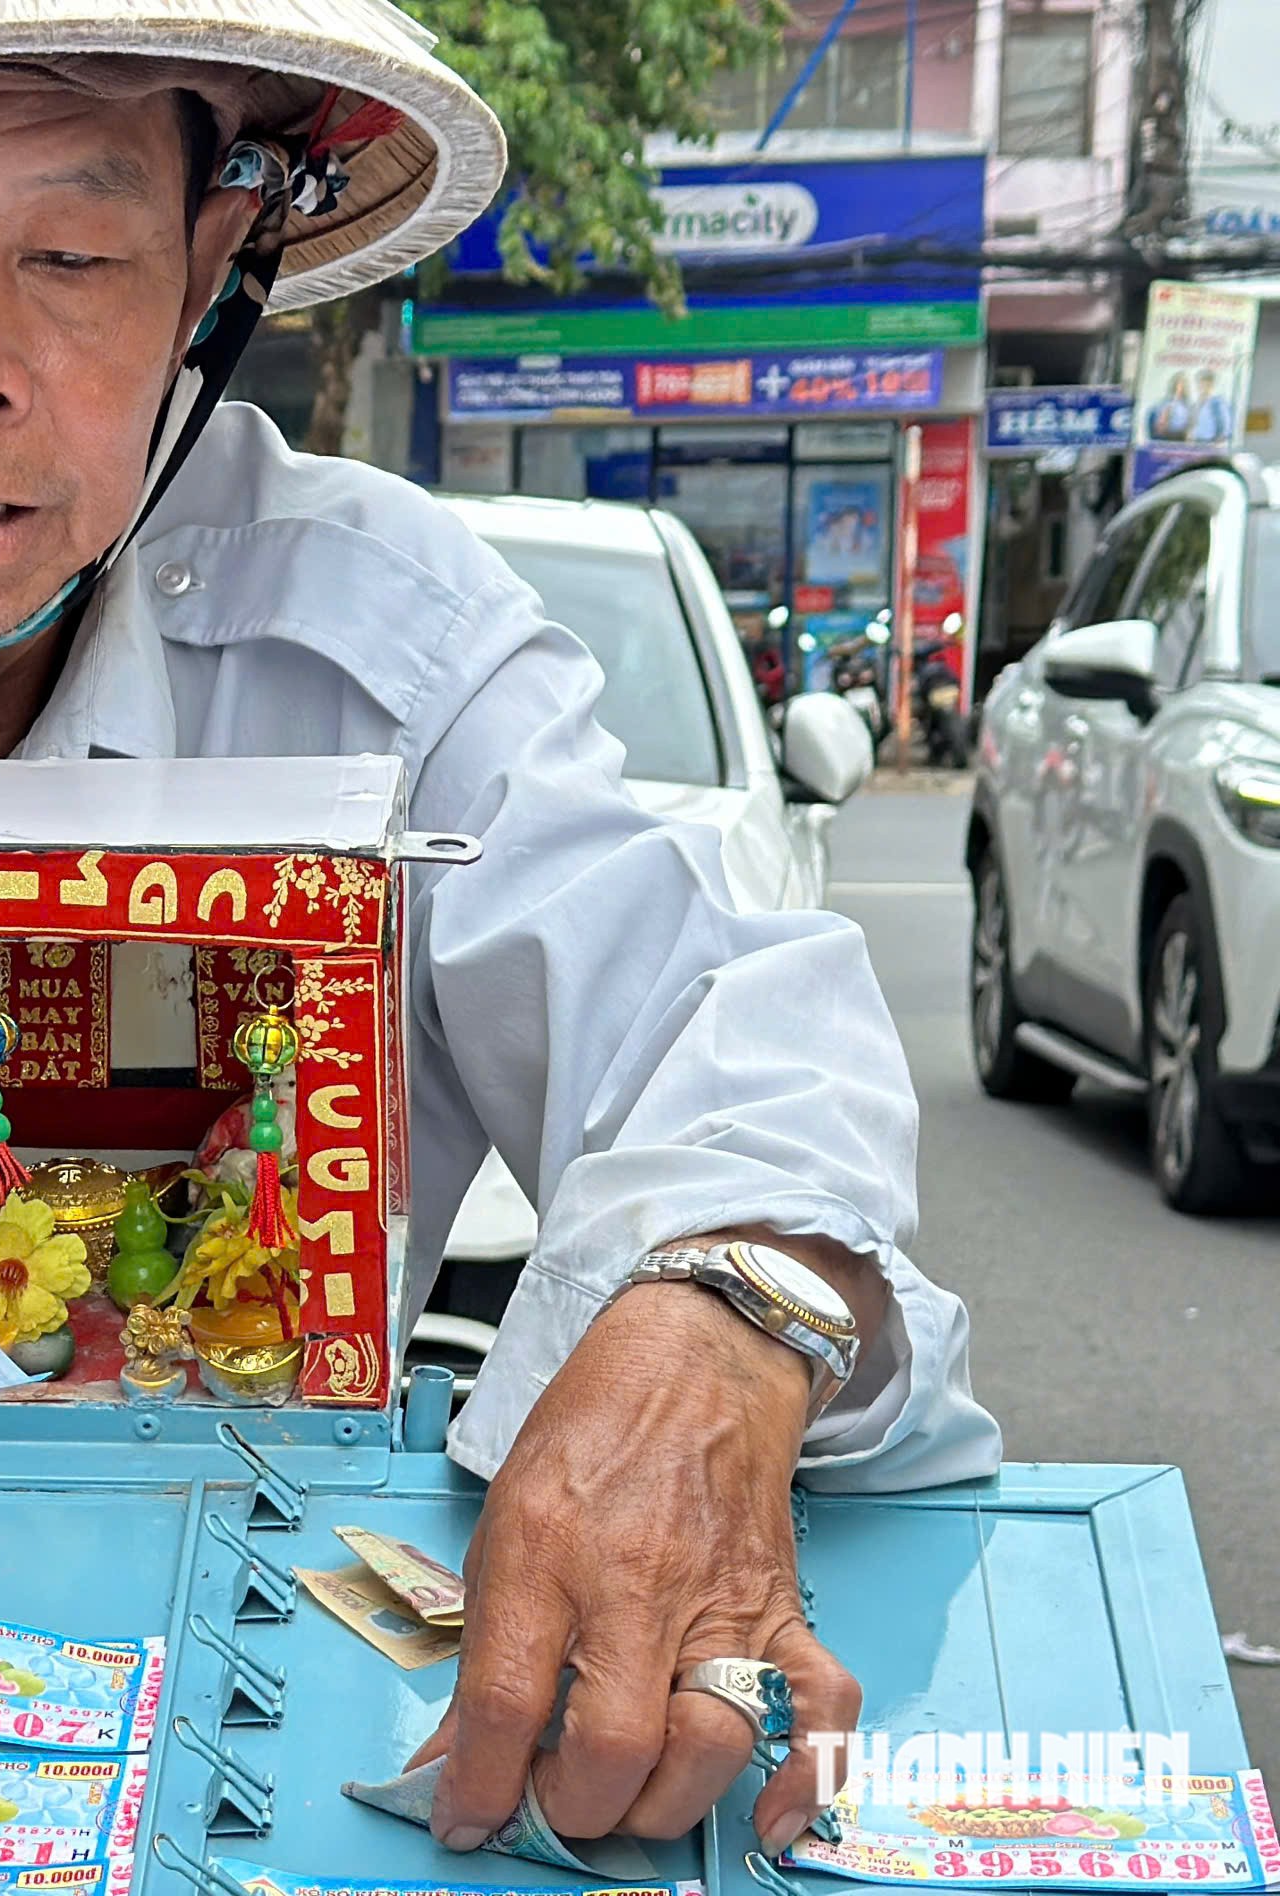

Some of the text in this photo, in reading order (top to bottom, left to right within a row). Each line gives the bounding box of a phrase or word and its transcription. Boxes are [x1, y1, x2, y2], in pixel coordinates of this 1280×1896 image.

[671, 205, 799, 241] rmacity
[19, 978, 83, 998] MUA
[19, 1006, 83, 1025] MAY
[20, 1027, 82, 1052] BÁN
[68, 1644, 136, 1665] 10.000đ
[97, 1728, 116, 1741] K
[43, 1764, 114, 1777] 10.000đ
[842, 1842, 900, 1857] 2T7
[948, 1839, 964, 1848] M
[71, 1848, 91, 1861] H
[807, 1850, 916, 1876] 10-07-2024
[934, 1850, 1248, 1880] 395609 M
[23, 1867, 97, 1885] 10.000đ
